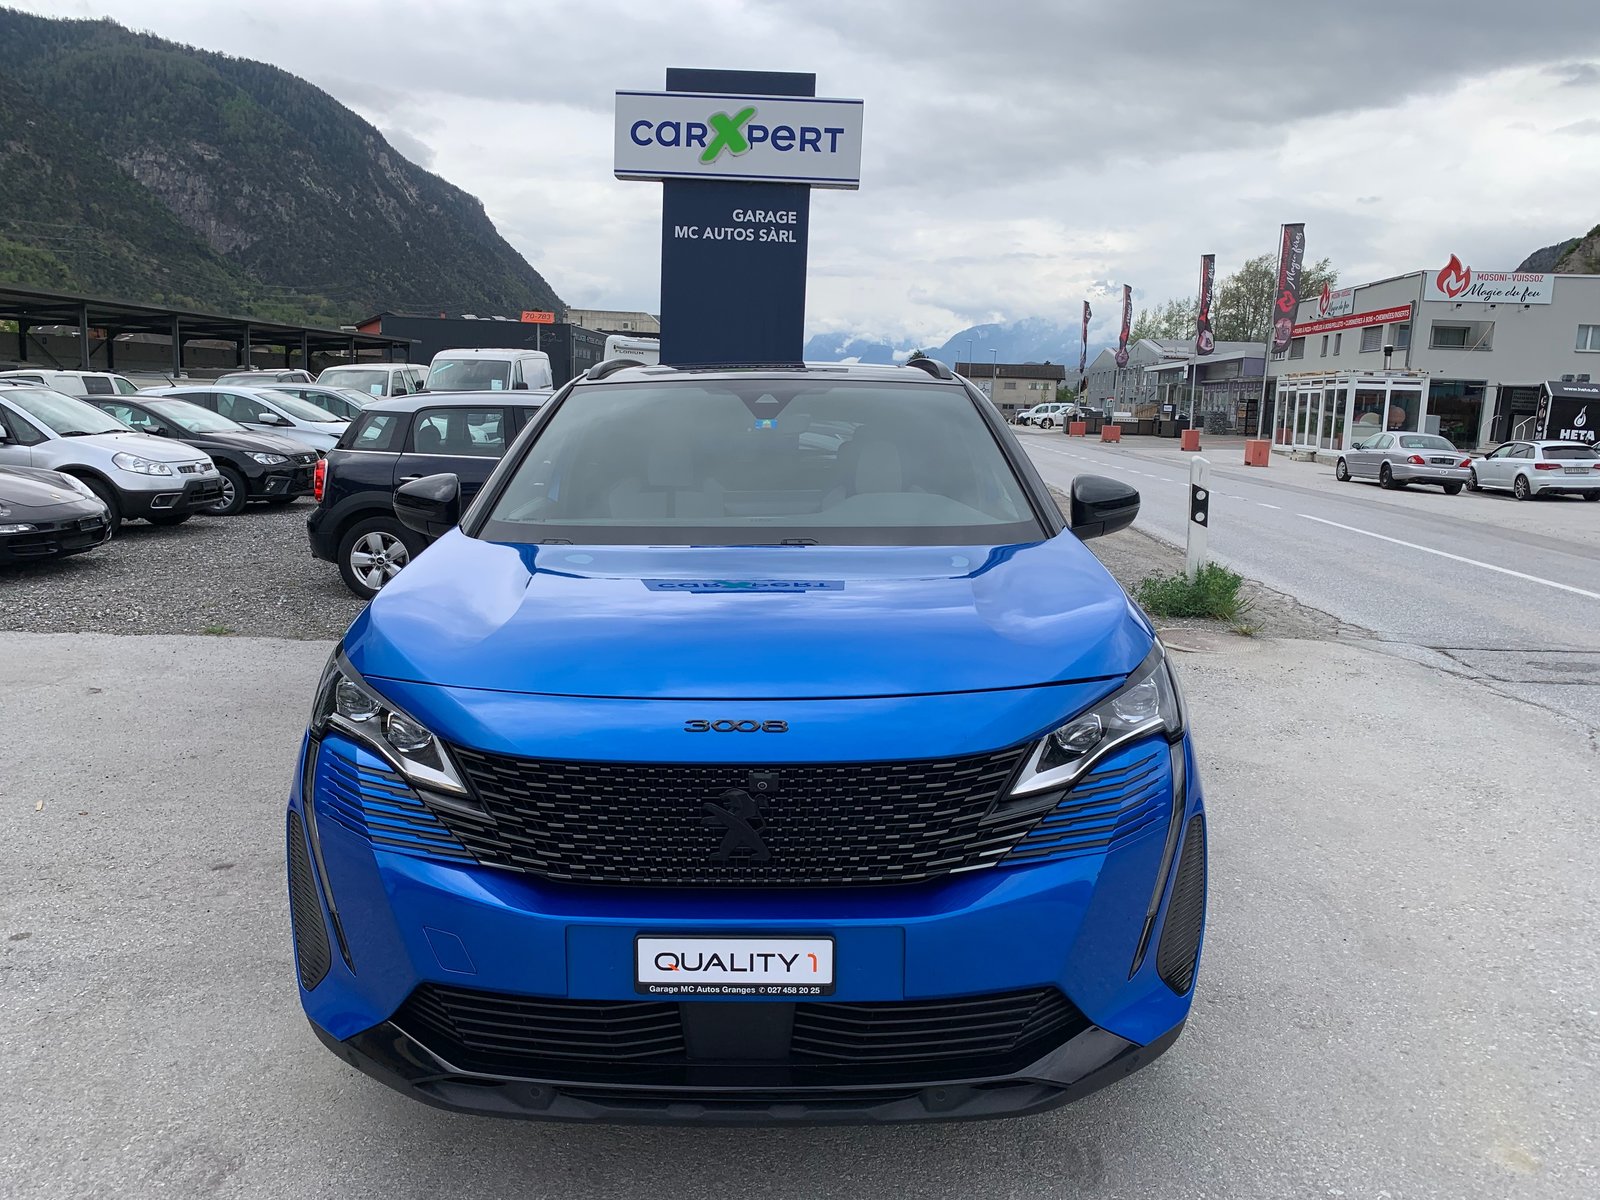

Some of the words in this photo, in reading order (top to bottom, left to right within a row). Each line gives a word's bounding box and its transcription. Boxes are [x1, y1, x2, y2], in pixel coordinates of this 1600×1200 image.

[732, 209, 797, 224] GARAGE
[674, 225, 699, 239] MC
[703, 226, 755, 242] AUTOS
[759, 226, 797, 243] SÀRL
[1476, 273, 1544, 283] MOSONI-VUISSOZ
[1461, 283, 1503, 301] Magie
[1505, 286, 1520, 297] du
[1520, 286, 1541, 302] feu
[1560, 428, 1595, 441] HETA
[684, 719, 789, 733] 3008
[654, 952, 800, 972] QUALITY
[807, 952, 818, 973] 1
[649, 985, 679, 994] Garage
[681, 985, 694, 993] MC
[697, 985, 720, 993] Autos
[722, 985, 756, 995] Granges
[767, 986, 782, 994] 027
[782, 986, 797, 994] 458
[799, 986, 809, 994] 20
[810, 986, 820, 994] 25
